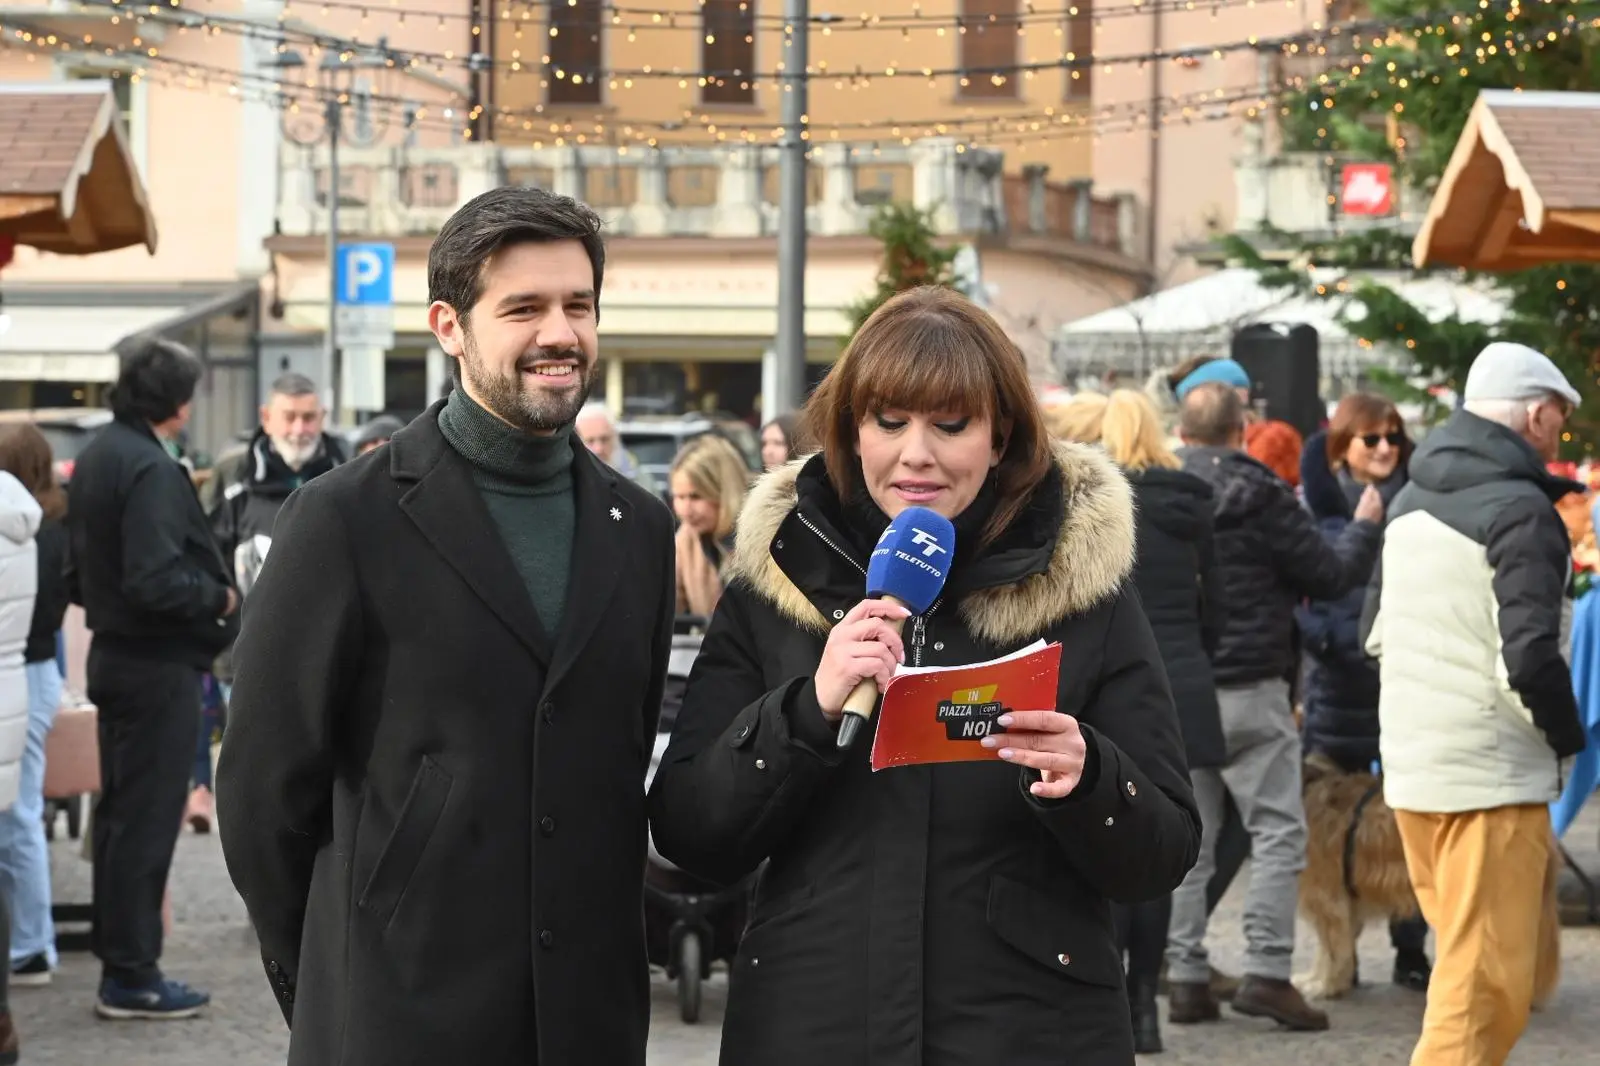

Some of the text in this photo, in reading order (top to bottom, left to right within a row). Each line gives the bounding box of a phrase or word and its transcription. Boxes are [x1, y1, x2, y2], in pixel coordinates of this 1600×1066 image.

[346, 250, 382, 301] P
[895, 550, 942, 577] TELETUTTO
[967, 690, 979, 702] IN
[939, 705, 997, 717] PIAZZA con
[962, 720, 993, 737] NOI
